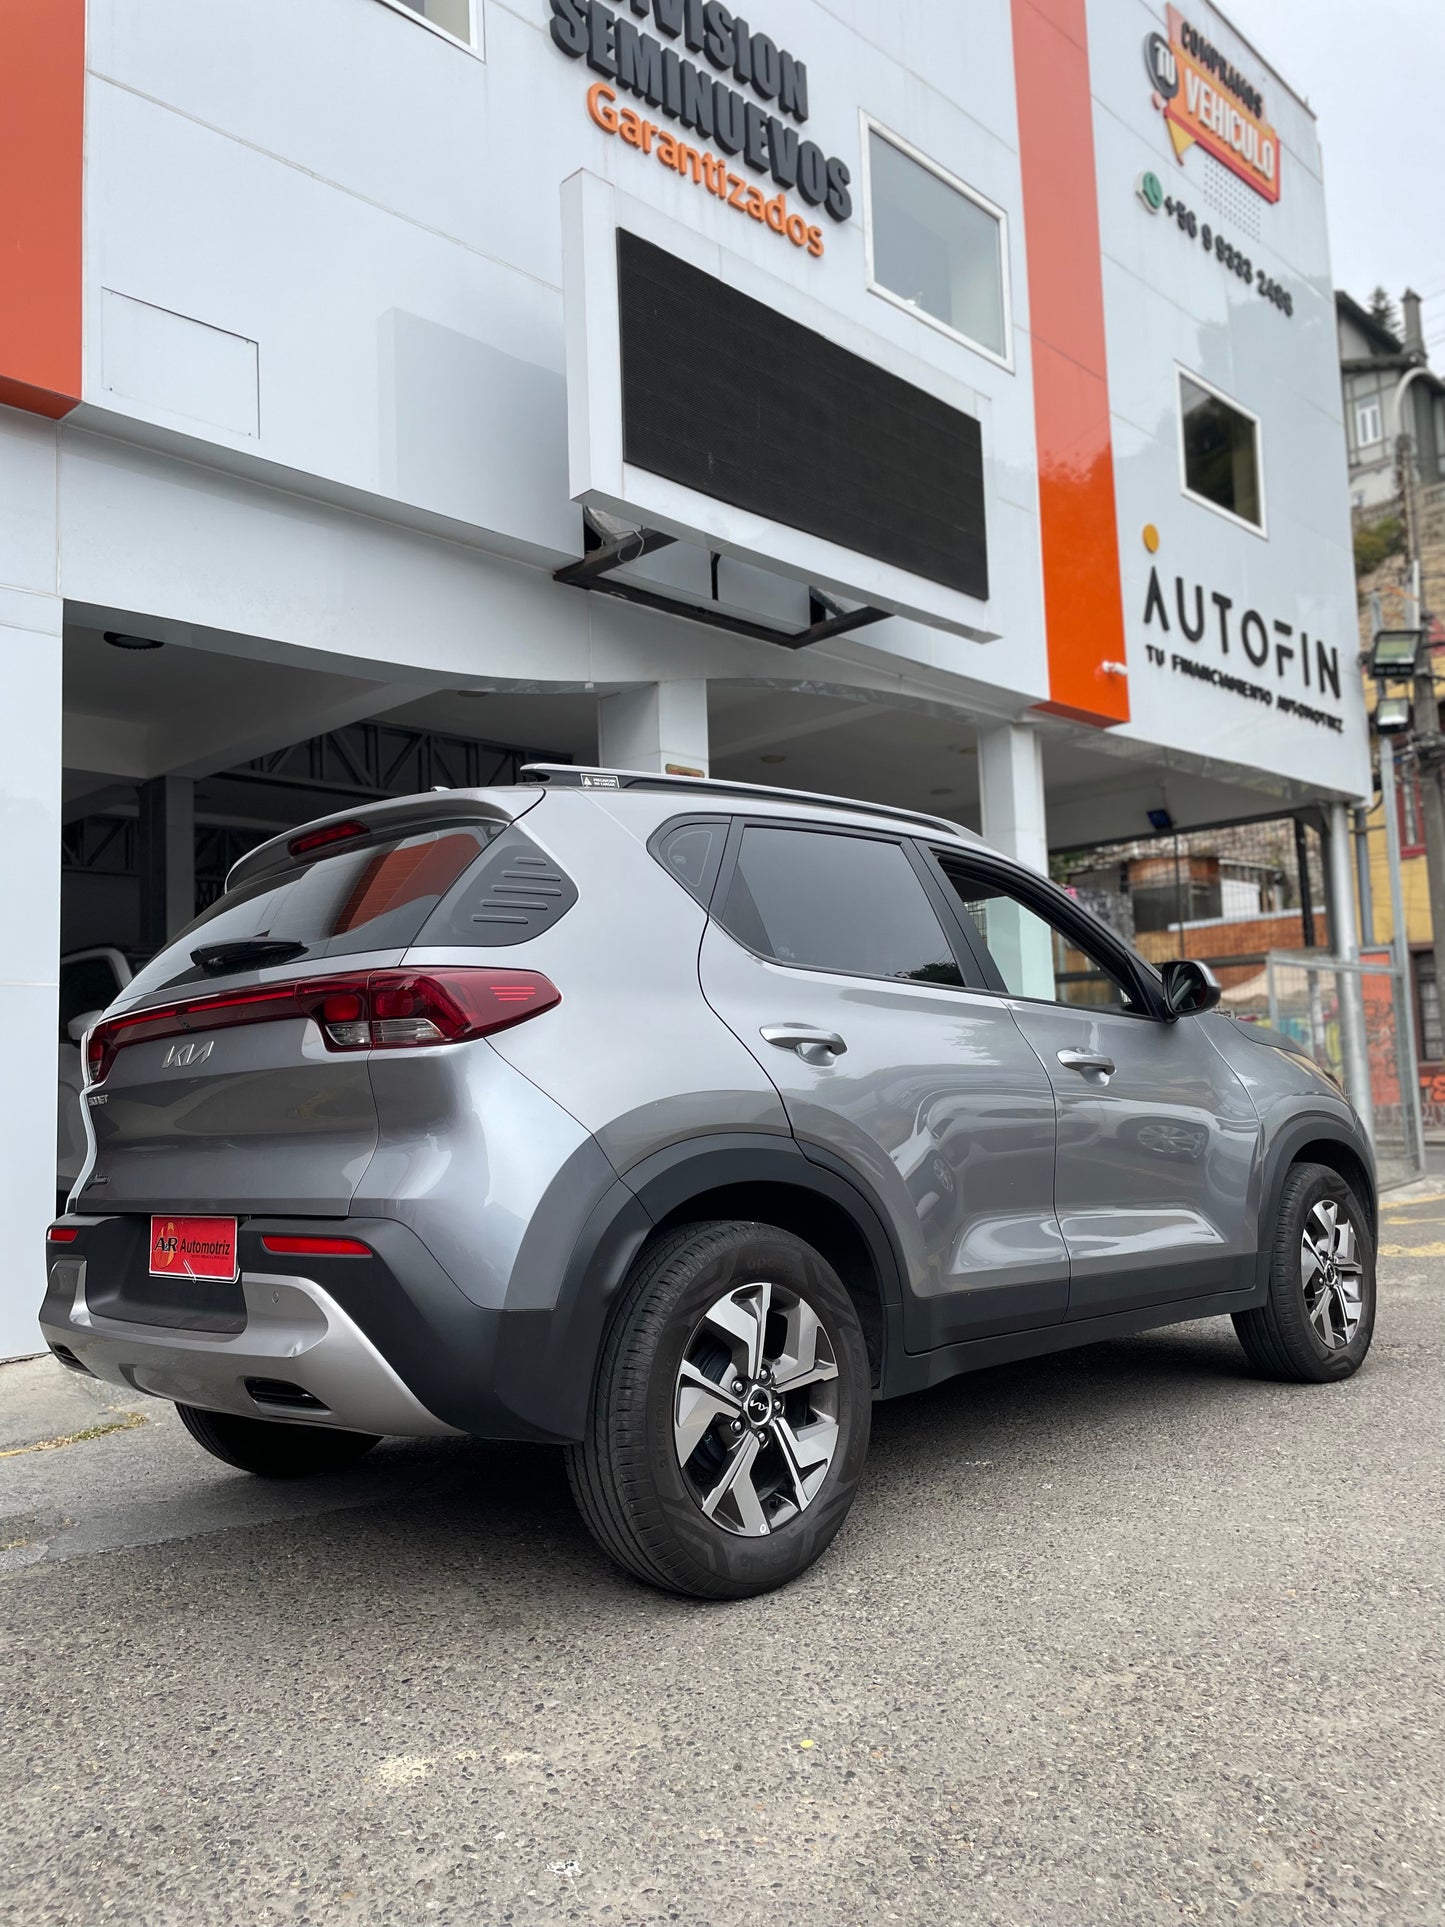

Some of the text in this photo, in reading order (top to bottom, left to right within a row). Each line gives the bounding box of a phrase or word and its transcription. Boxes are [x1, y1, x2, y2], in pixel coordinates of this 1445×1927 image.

[550, 0, 852, 222] SEMINUEVOS
[615, 0, 809, 124] VISION
[1155, 41, 1176, 86] TU
[1181, 21, 1263, 119] COMPRAMOS
[587, 82, 825, 258] Garantizados
[1184, 68, 1275, 181] VEHICULO
[1201, 224, 1212, 251] 9
[1143, 565, 1341, 700] AUTOFIN
[1145, 644, 1165, 667] TU
[1171, 654, 1273, 706] FINANCIAMIENTO
[162, 1040, 215, 1069] KIA
[180, 1237, 231, 1256] Automotriz
